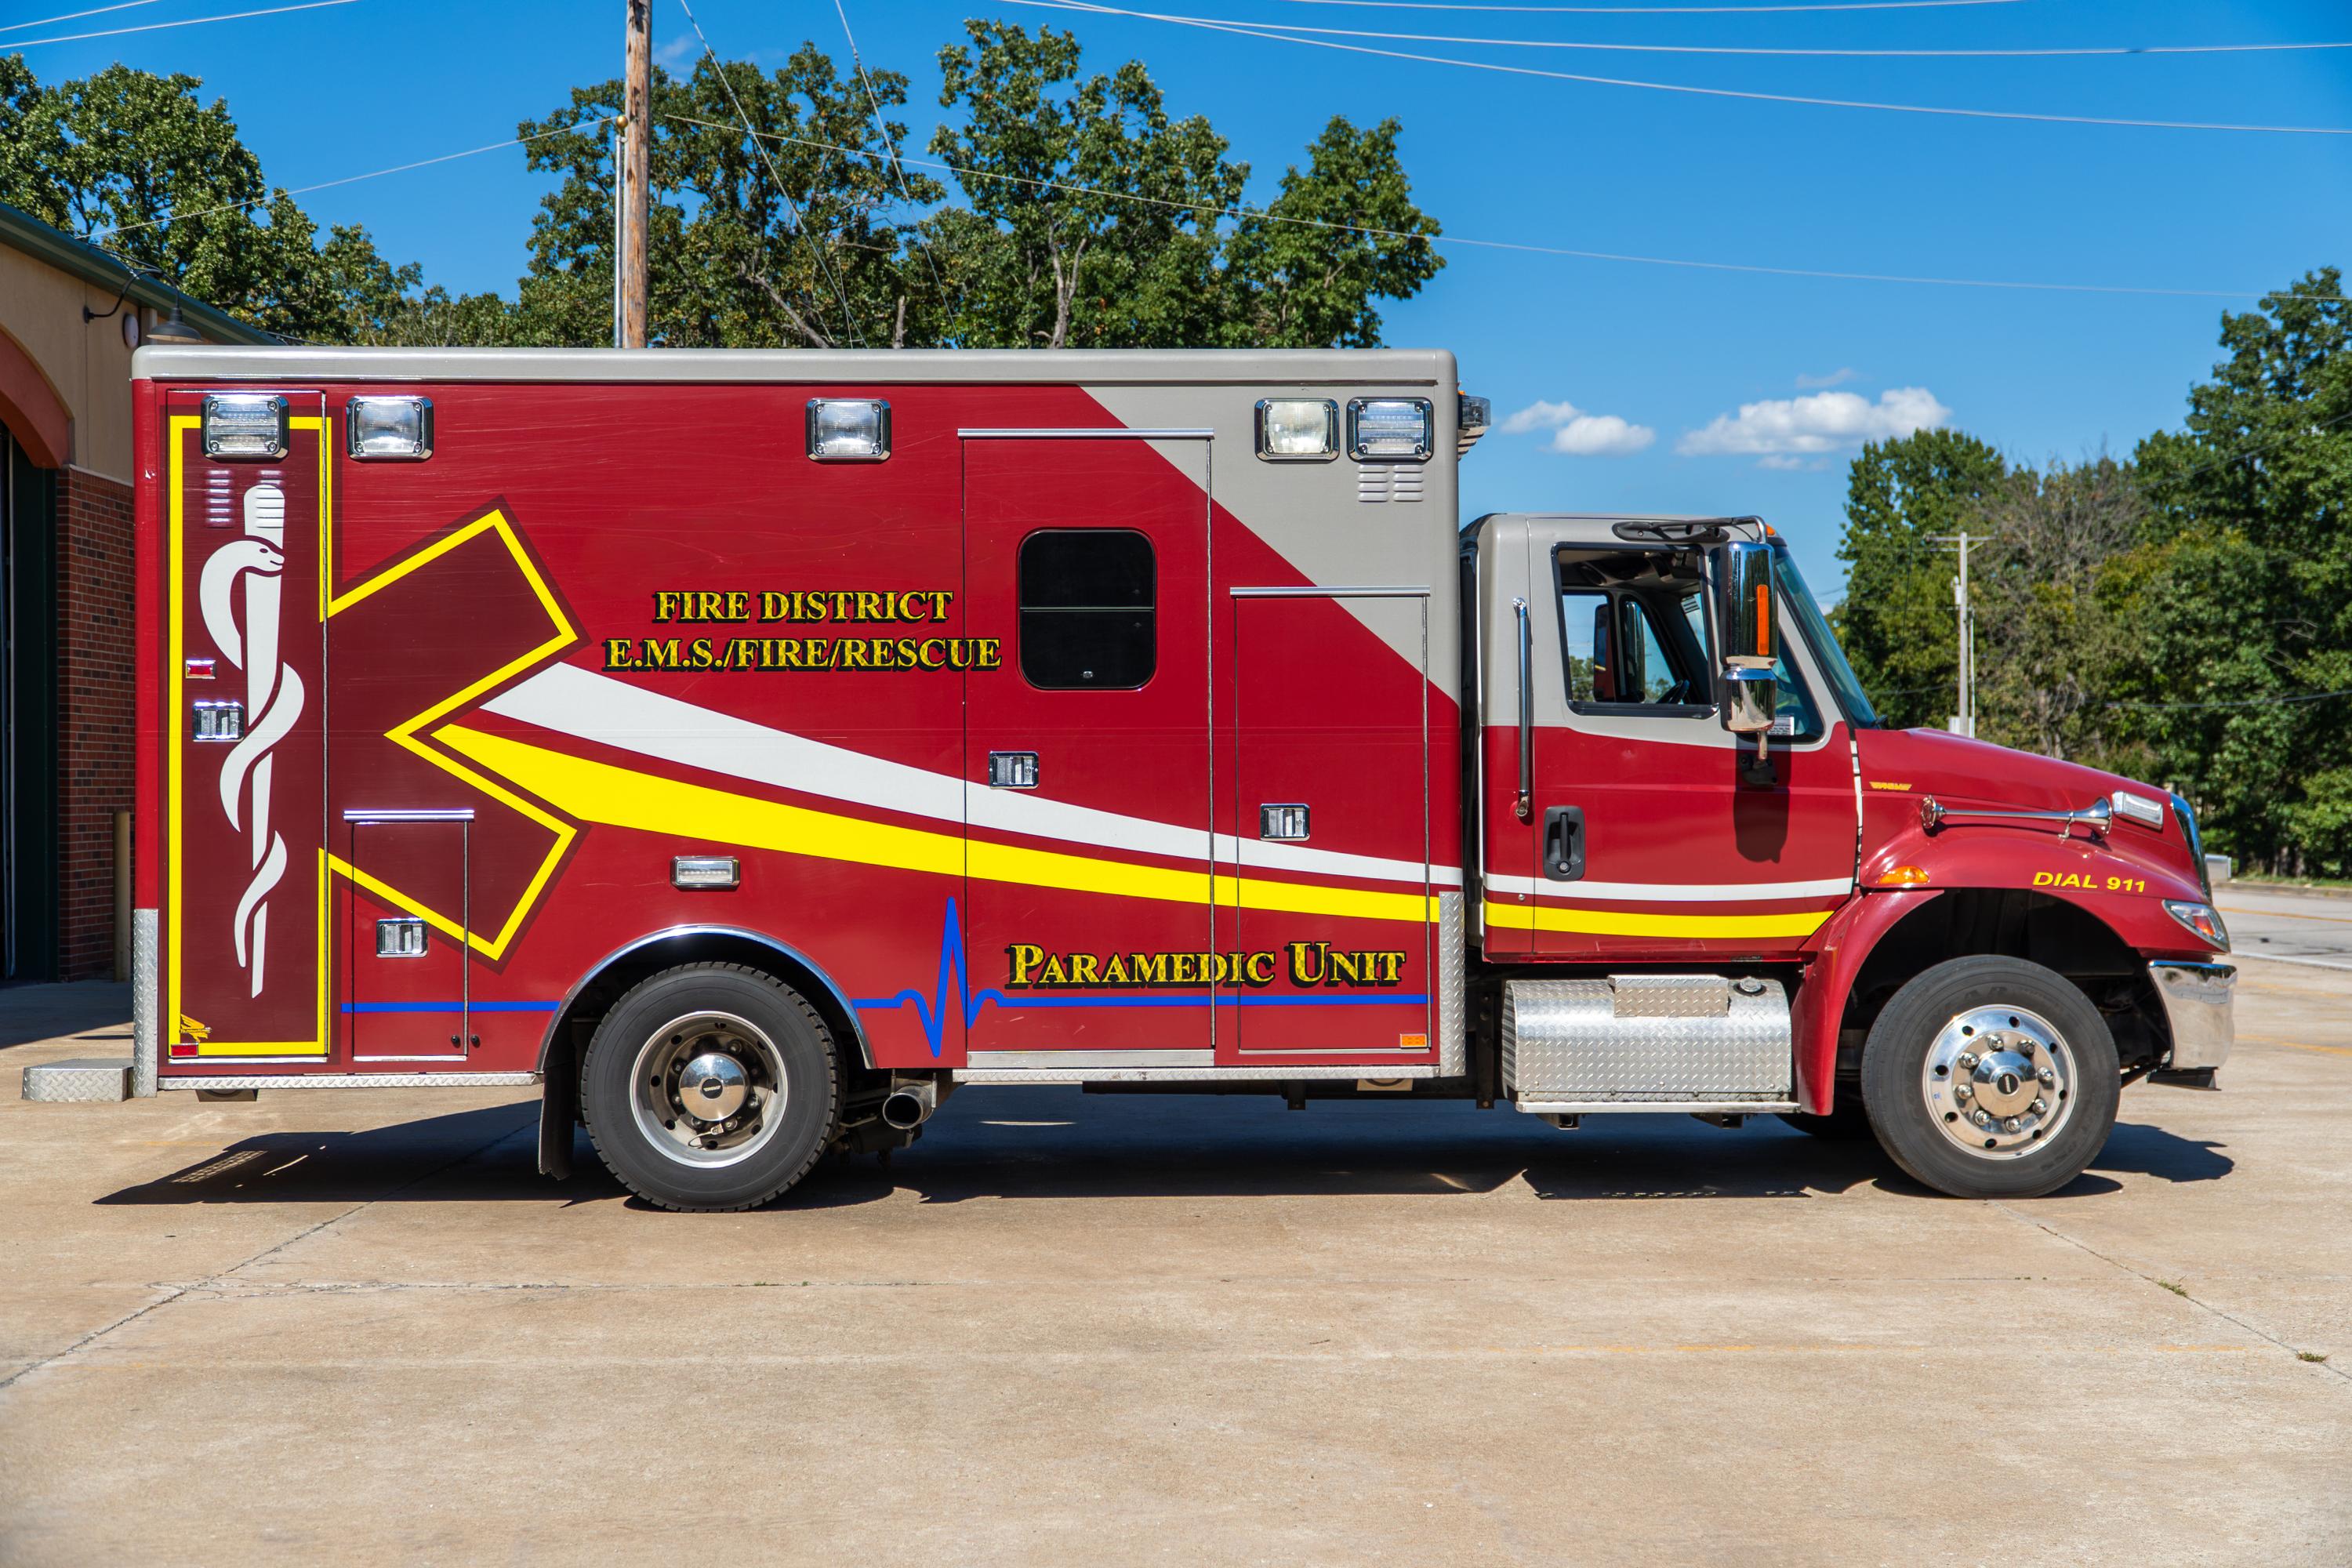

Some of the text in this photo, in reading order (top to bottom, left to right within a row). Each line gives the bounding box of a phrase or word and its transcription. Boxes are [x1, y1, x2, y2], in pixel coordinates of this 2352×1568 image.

[658, 591, 955, 621] FIRE DISTRICT
[608, 638, 1003, 669] E.M.S./FIRE/RESCUE
[2033, 872, 2147, 894] DIAL 911
[1011, 942, 1406, 985] PARAMEDIC UNIT
